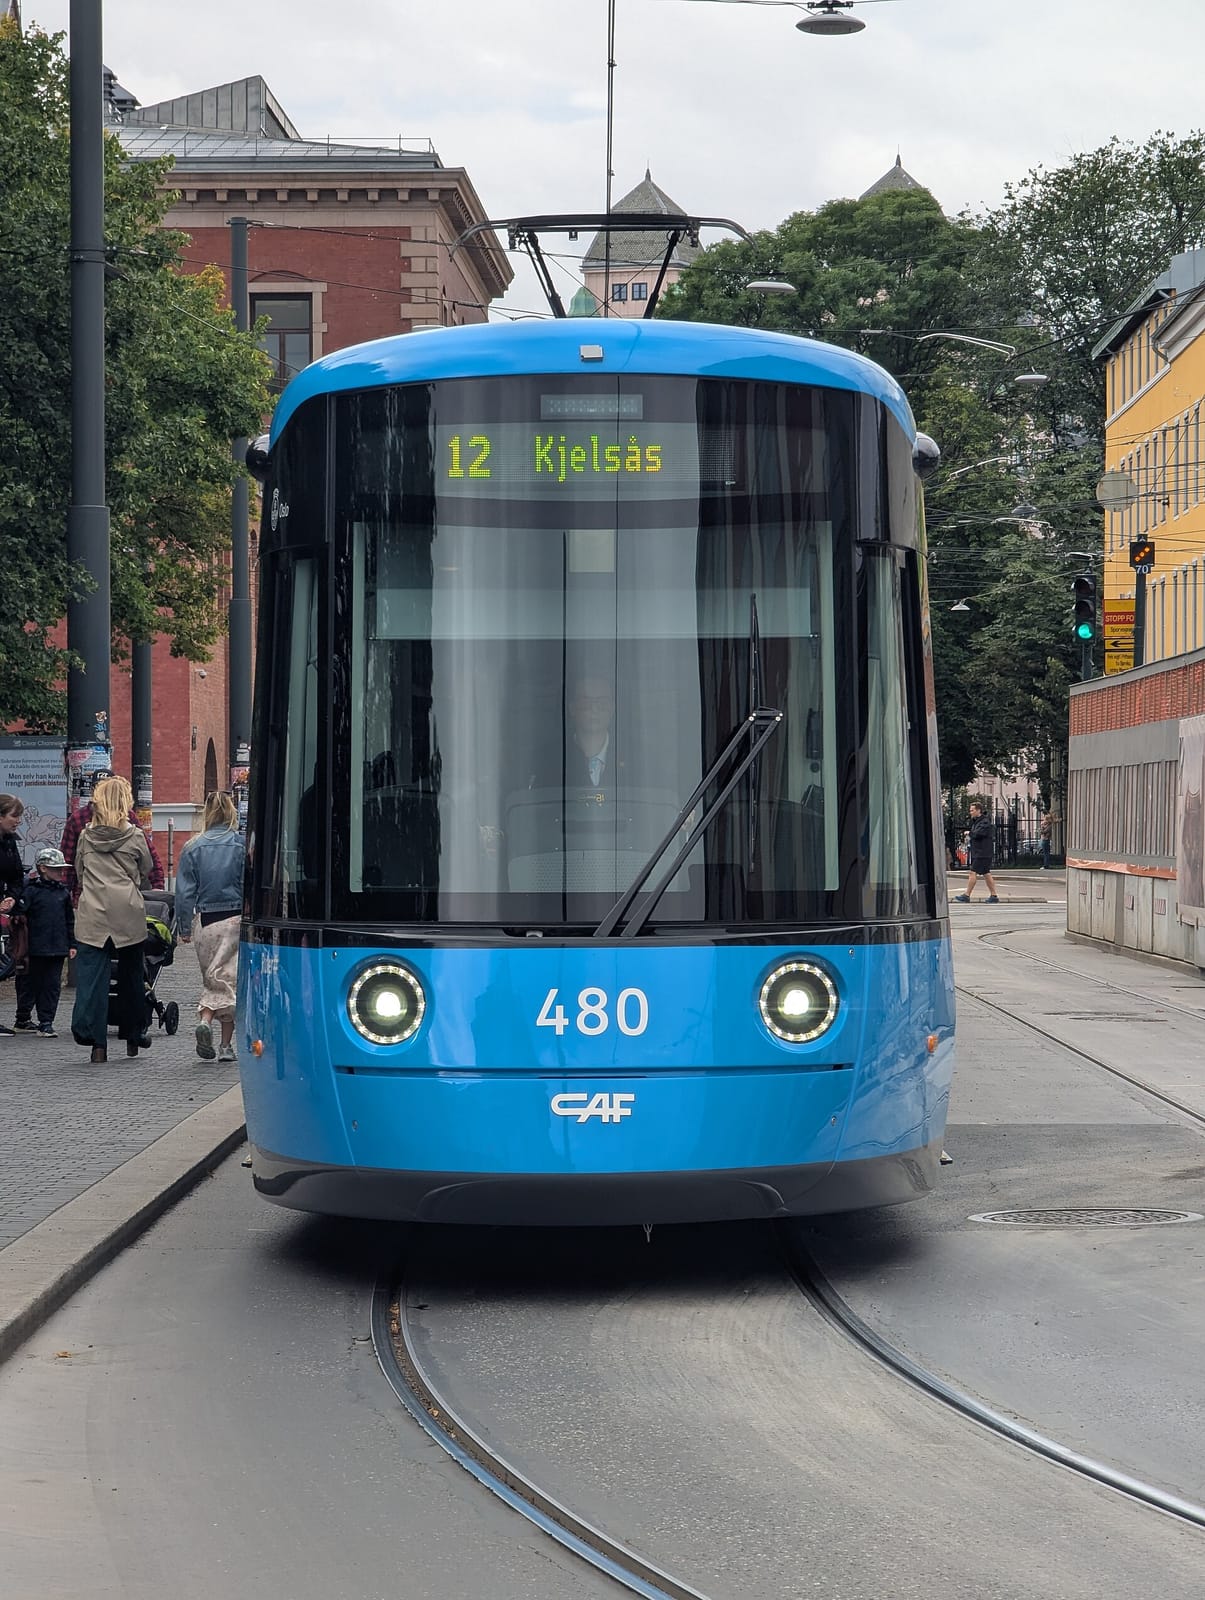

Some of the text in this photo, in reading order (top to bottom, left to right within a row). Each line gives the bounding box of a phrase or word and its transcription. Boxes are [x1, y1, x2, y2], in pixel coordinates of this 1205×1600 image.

[447, 434, 663, 483] 12 Kjelsås
[1135, 565, 1149, 574] 70
[1105, 614, 1135, 622] STOPP FO
[536, 987, 649, 1036] 480
[551, 1093, 635, 1123] CAF
